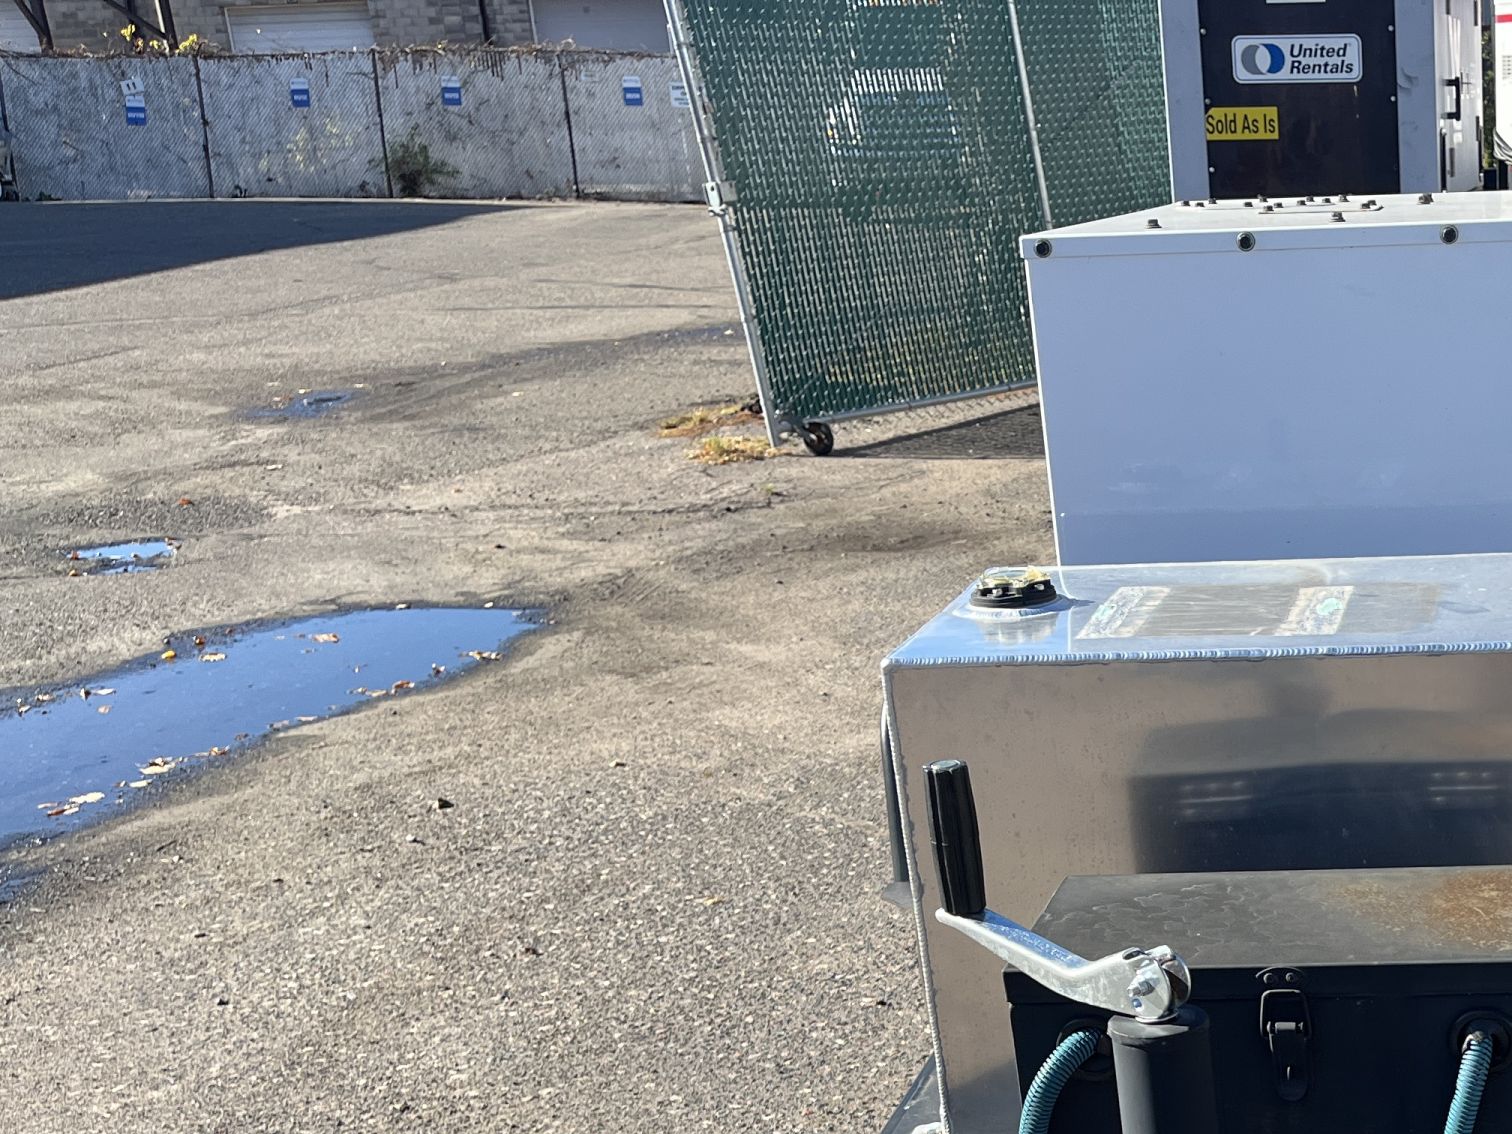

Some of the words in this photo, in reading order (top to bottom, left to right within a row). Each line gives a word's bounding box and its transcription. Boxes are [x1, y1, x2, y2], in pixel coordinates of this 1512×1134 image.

[1289, 43, 1347, 58] United
[1289, 60, 1354, 74] Rentals
[1206, 113, 1237, 134] Sold
[1241, 114, 1259, 133] As
[1263, 113, 1276, 133] Is
